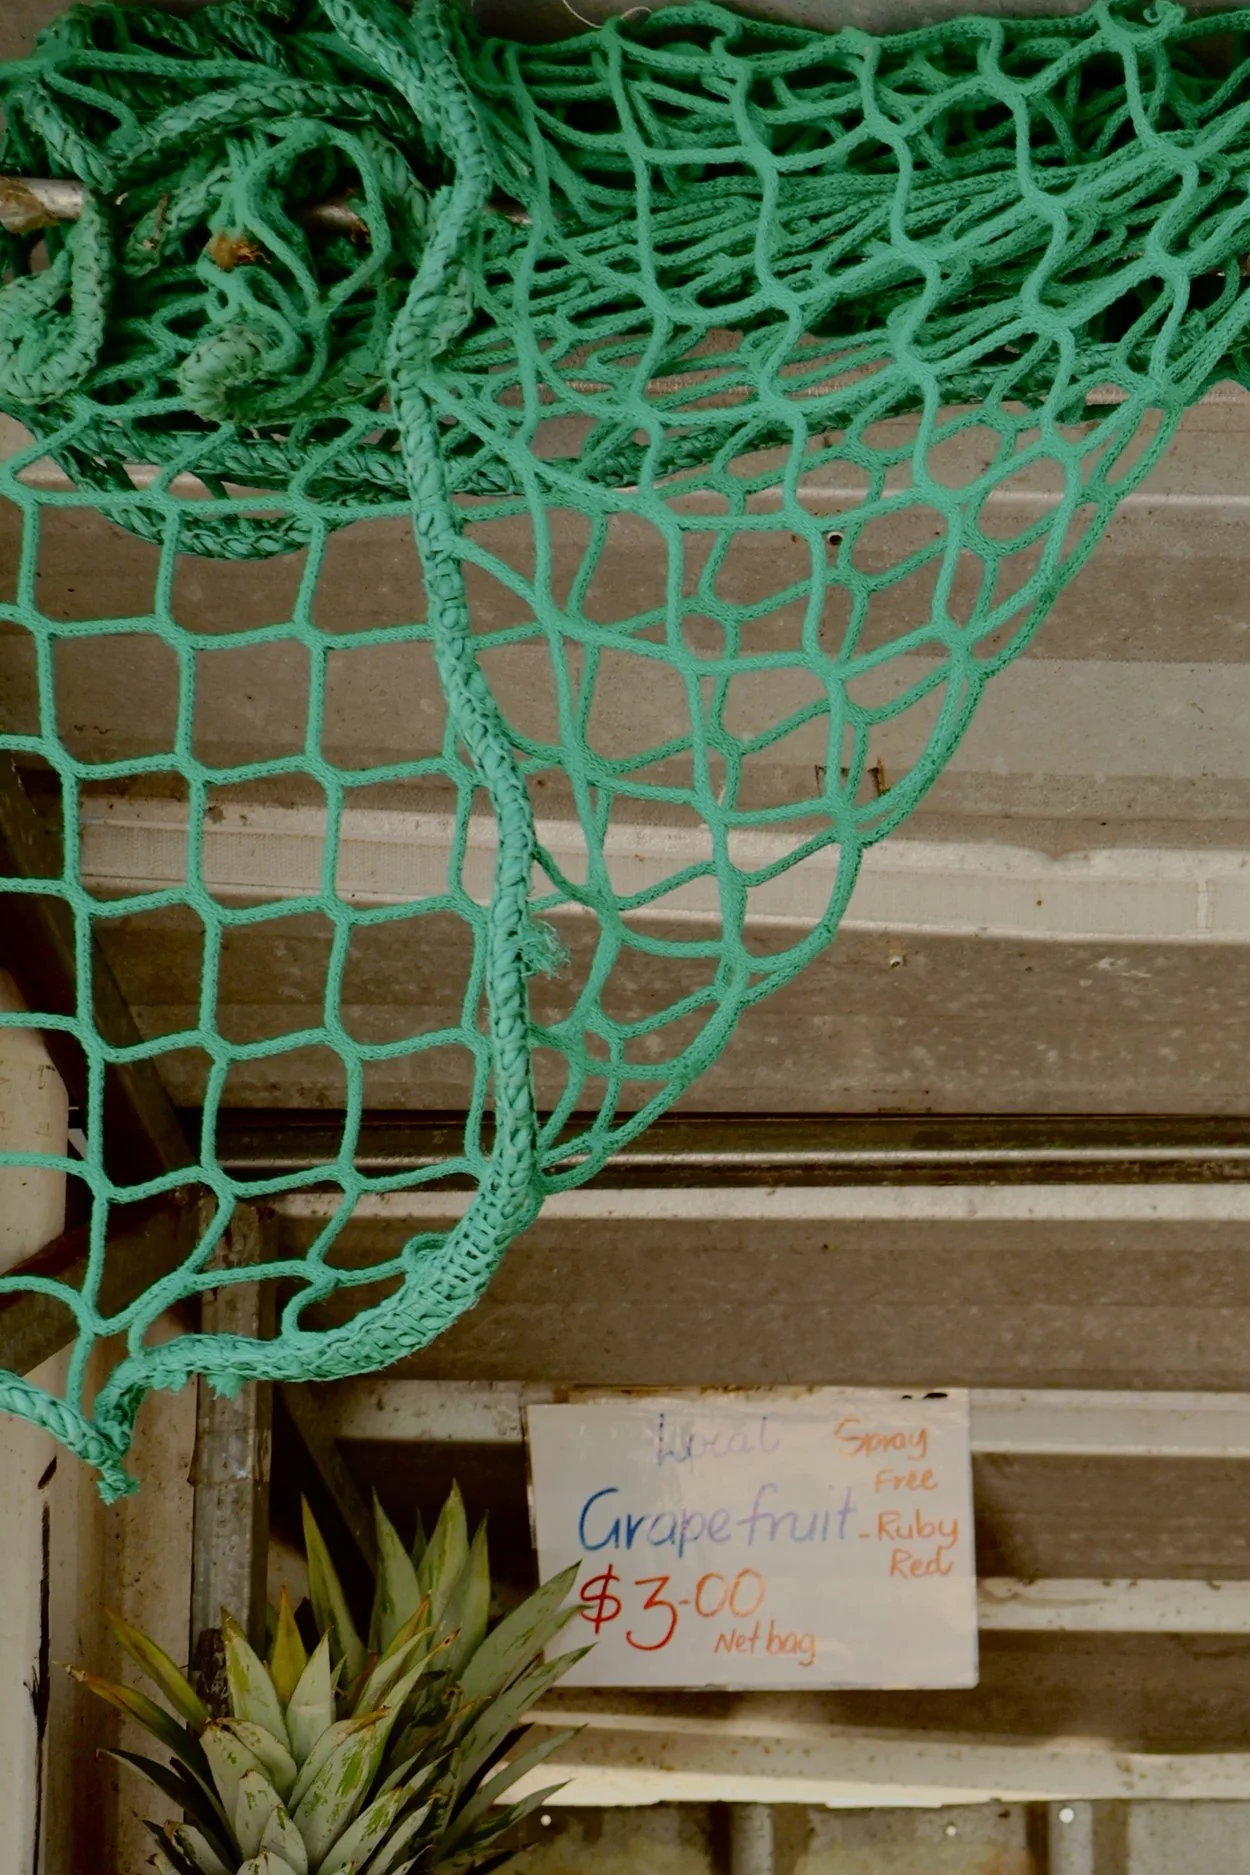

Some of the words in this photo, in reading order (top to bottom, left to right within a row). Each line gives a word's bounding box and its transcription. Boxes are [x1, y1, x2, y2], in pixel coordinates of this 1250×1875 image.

[833, 1414, 928, 1461] Spray
[873, 1468, 939, 1494] Free
[578, 1483, 857, 1558] Grapefruit
[889, 1545, 954, 1579] Red
